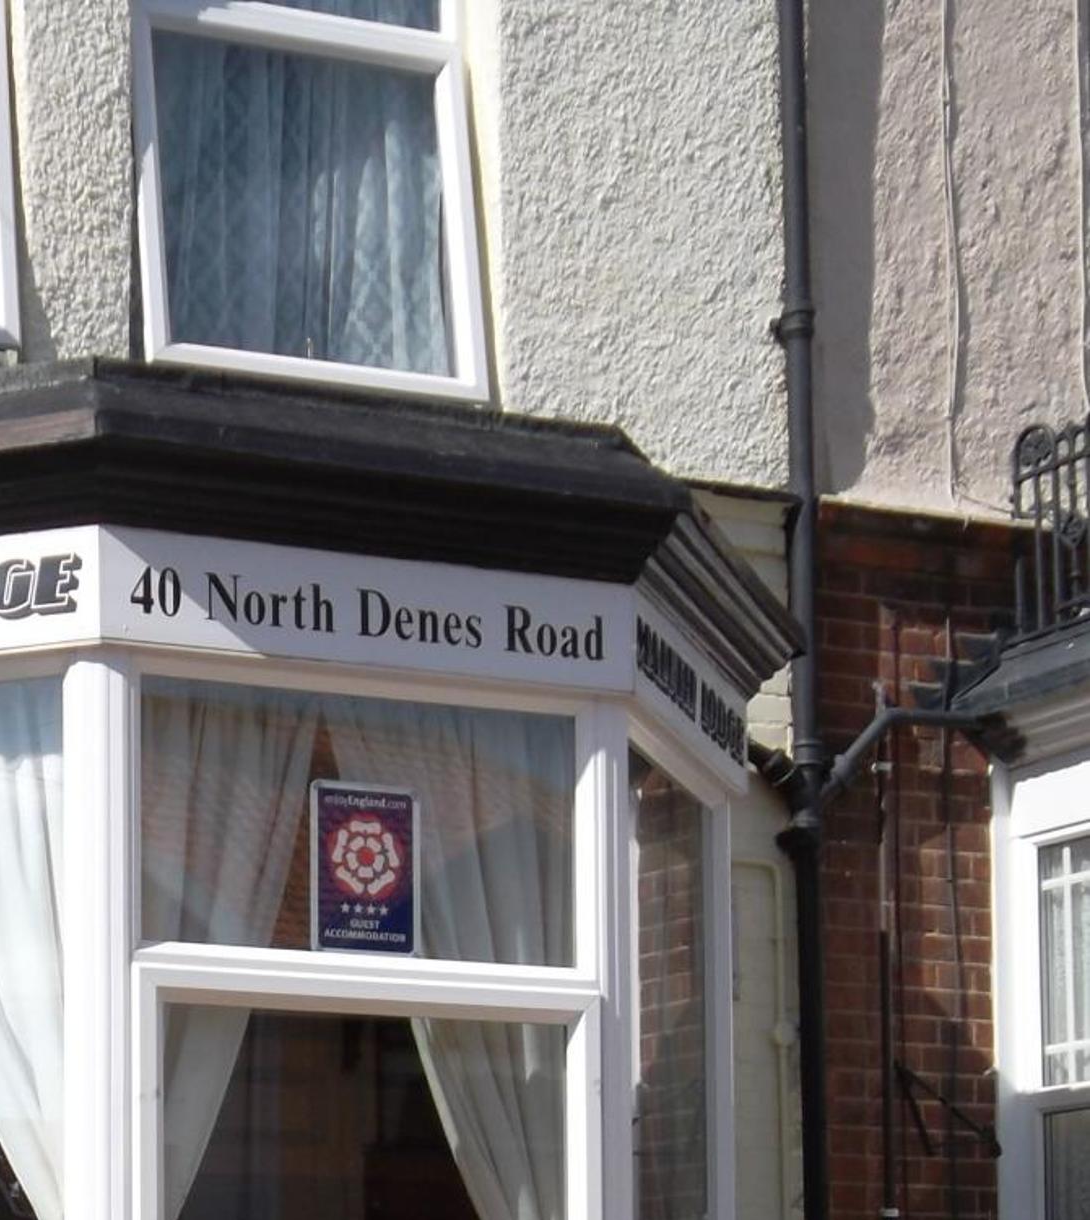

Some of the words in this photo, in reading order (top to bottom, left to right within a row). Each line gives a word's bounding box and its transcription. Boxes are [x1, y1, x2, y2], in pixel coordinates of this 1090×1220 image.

[130, 567, 182, 617] 40
[205, 572, 335, 634] North
[357, 587, 483, 650] Denes
[504, 604, 607, 662] Road
[349, 918, 381, 930] GUEST
[323, 927, 407, 943] ACCOMMODATION
